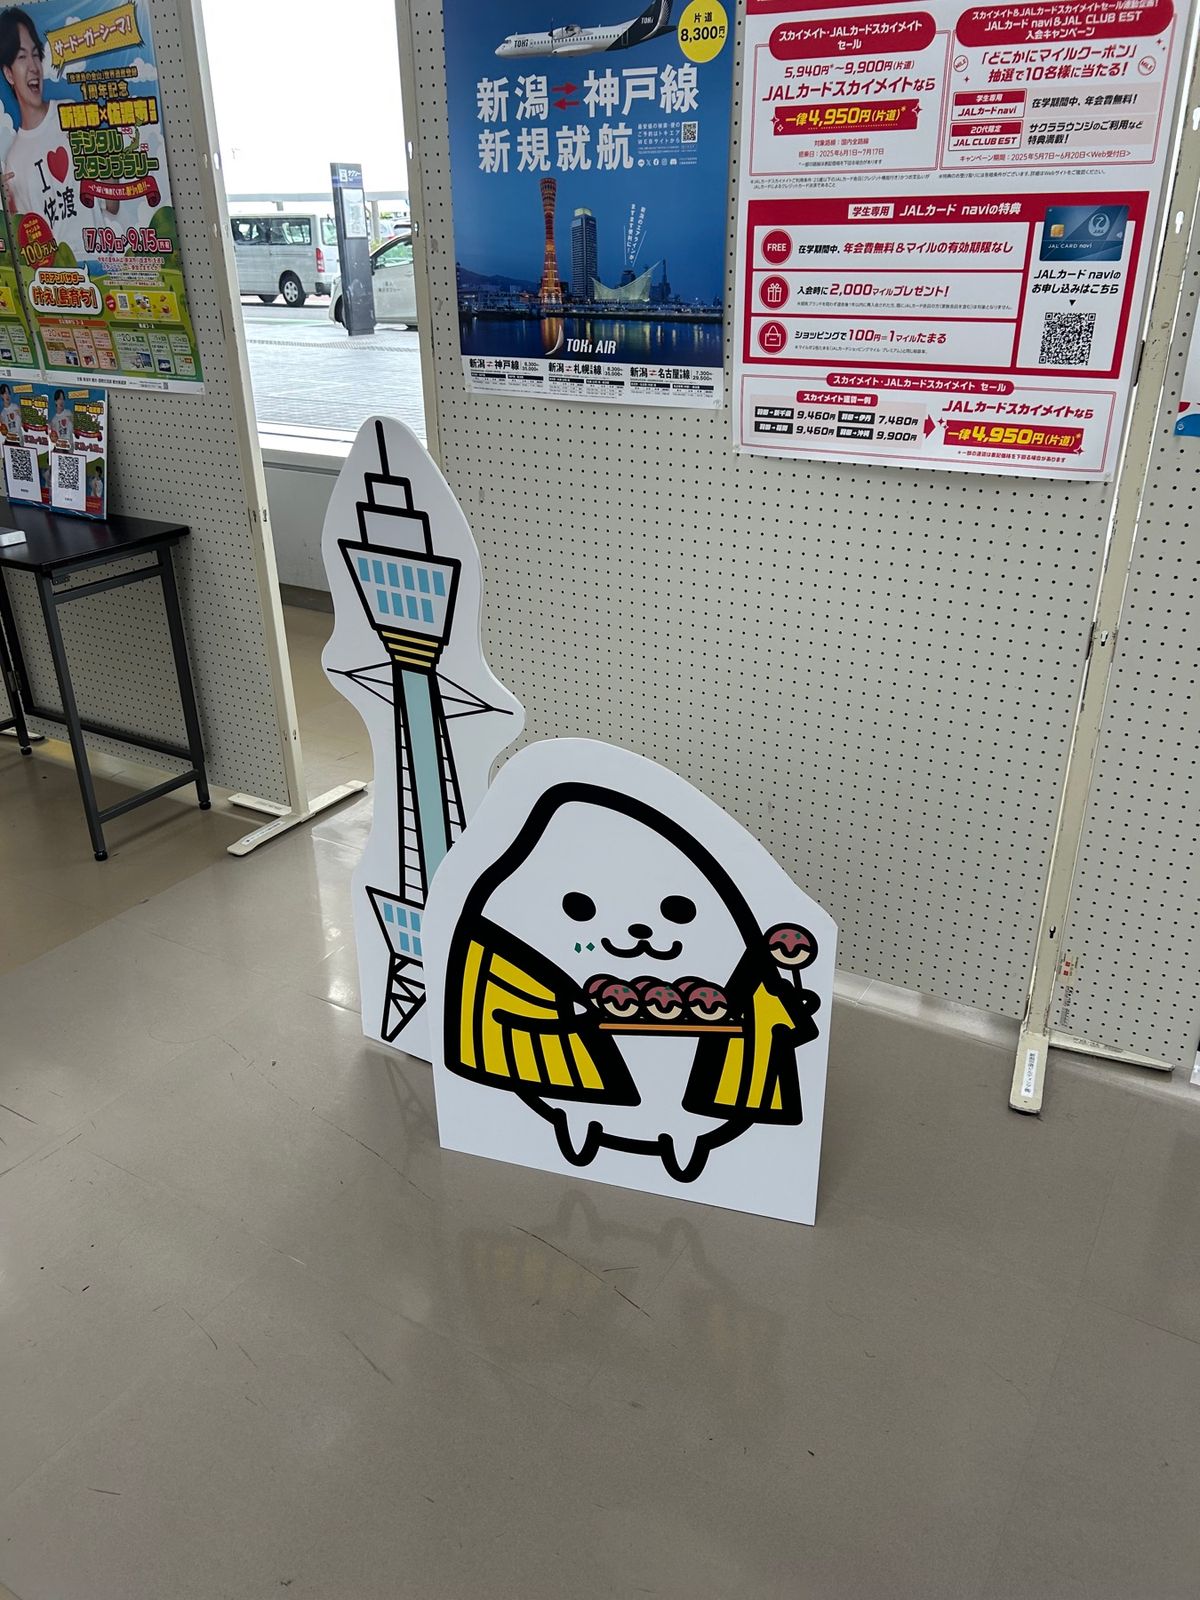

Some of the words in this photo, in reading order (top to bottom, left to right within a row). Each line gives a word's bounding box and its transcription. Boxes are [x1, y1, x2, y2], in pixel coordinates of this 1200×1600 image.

[693, 12, 714, 23] 片道
[984, 17, 1029, 32] JALカード
[1085, 12, 1116, 24] CLUB
[1118, 9, 1143, 23] EST
[779, 20, 923, 41] スカイメイト・JALカードスカイメイト
[1025, 28, 1096, 40] 入会キャンペーン
[838, 39, 862, 50] セール
[981, 43, 1138, 66] 「どこかにマイルクーポン」
[988, 62, 1129, 83] 抽選で10名様に当たる！
[81, 81, 128, 100] 1周年記念
[476, 73, 549, 123] 新潟
[583, 62, 699, 118] 神戸線
[762, 76, 936, 101] JALカードスカイメイトなら
[975, 93, 1003, 103] 学生専用
[1031, 92, 1138, 109] 在学期間中、年会費無料！
[970, 125, 1002, 134] 20代限定
[1028, 119, 1144, 133] サクララウンジのご利用など
[70, 129, 123, 155] デジタル
[953, 138, 971, 147] JAL
[972, 137, 997, 146] CLUB
[998, 136, 1018, 145] EST
[1027, 134, 1070, 145] 特典満載！
[478, 122, 634, 173] 新規就航
[74, 153, 159, 179] スタンプラリー
[34, 158, 51, 193] I
[44, 186, 77, 228] 佐渡
[852, 205, 890, 217] 学生専用
[899, 203, 956, 217] JALカード
[961, 202, 1022, 216] naviの特典
[767, 243, 787, 252] FREE
[1034, 269, 1087, 280] JALカード
[1088, 269, 1121, 280] naviの
[797, 283, 950, 297] 入会時に2,000マイルプレゼント！
[1031, 283, 1119, 295] お申し込みはこちら
[595, 340, 617, 355] AIR
[469, 358, 486, 369] 新潟
[494, 360, 519, 370] 神戸線
[548, 362, 564, 373] 新潟
[630, 366, 648, 378] 新潟
[833, 375, 975, 390] スカイメイト・JALカードスカイメイト
[980, 383, 1007, 392] セール
[942, 400, 1094, 419] JALカードスカイメイトなら
[796, 410, 836, 420] 9,460円
[878, 415, 918, 426] 7,480円
[795, 425, 835, 435] 9,460円
[876, 430, 918, 441] 9,900円
